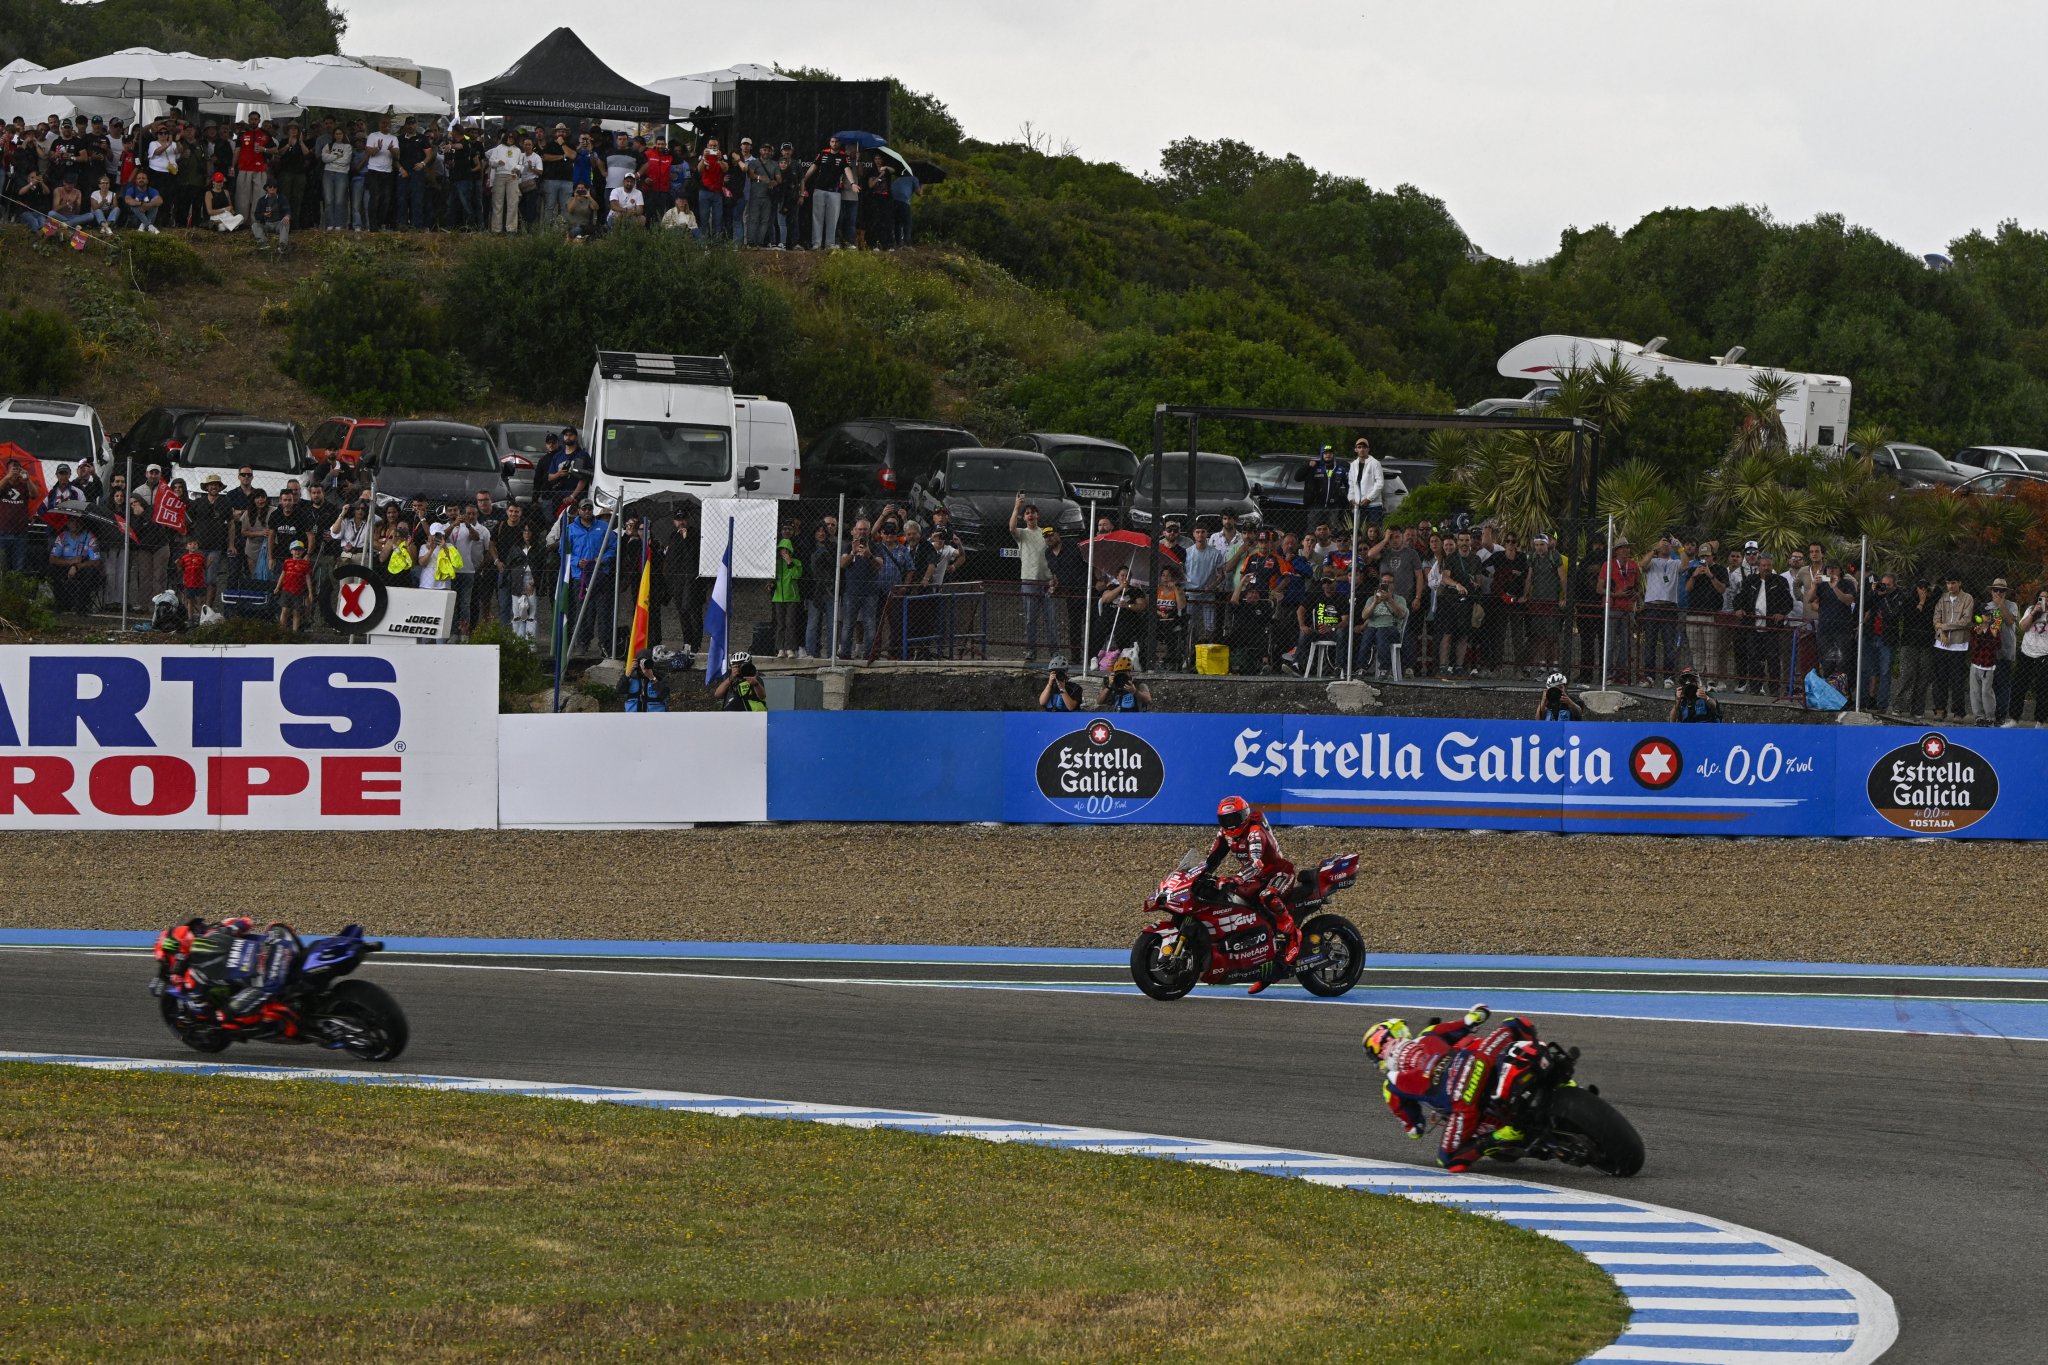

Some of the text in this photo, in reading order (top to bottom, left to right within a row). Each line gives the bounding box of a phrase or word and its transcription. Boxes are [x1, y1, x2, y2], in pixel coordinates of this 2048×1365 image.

[504, 98, 649, 113] www.embutidosgarcializana.com
[388, 624, 437, 635] LORENZO
[405, 615, 441, 625] JORGE
[0, 655, 402, 750] RTS
[1057, 746, 1143, 770] Estrella
[1229, 727, 1424, 781] Estrella
[1436, 731, 1614, 785] Galicia
[1724, 743, 1782, 786] 0,0
[1060, 769, 1139, 793] Galicia
[1890, 759, 1976, 784] Estrella
[0, 755, 402, 816] ROPE
[1893, 783, 1971, 807] Galicia
[1086, 794, 1114, 815] 0,0
[1909, 819, 1955, 828] TOSTADA
[1240, 945, 1270, 960] NetApp
